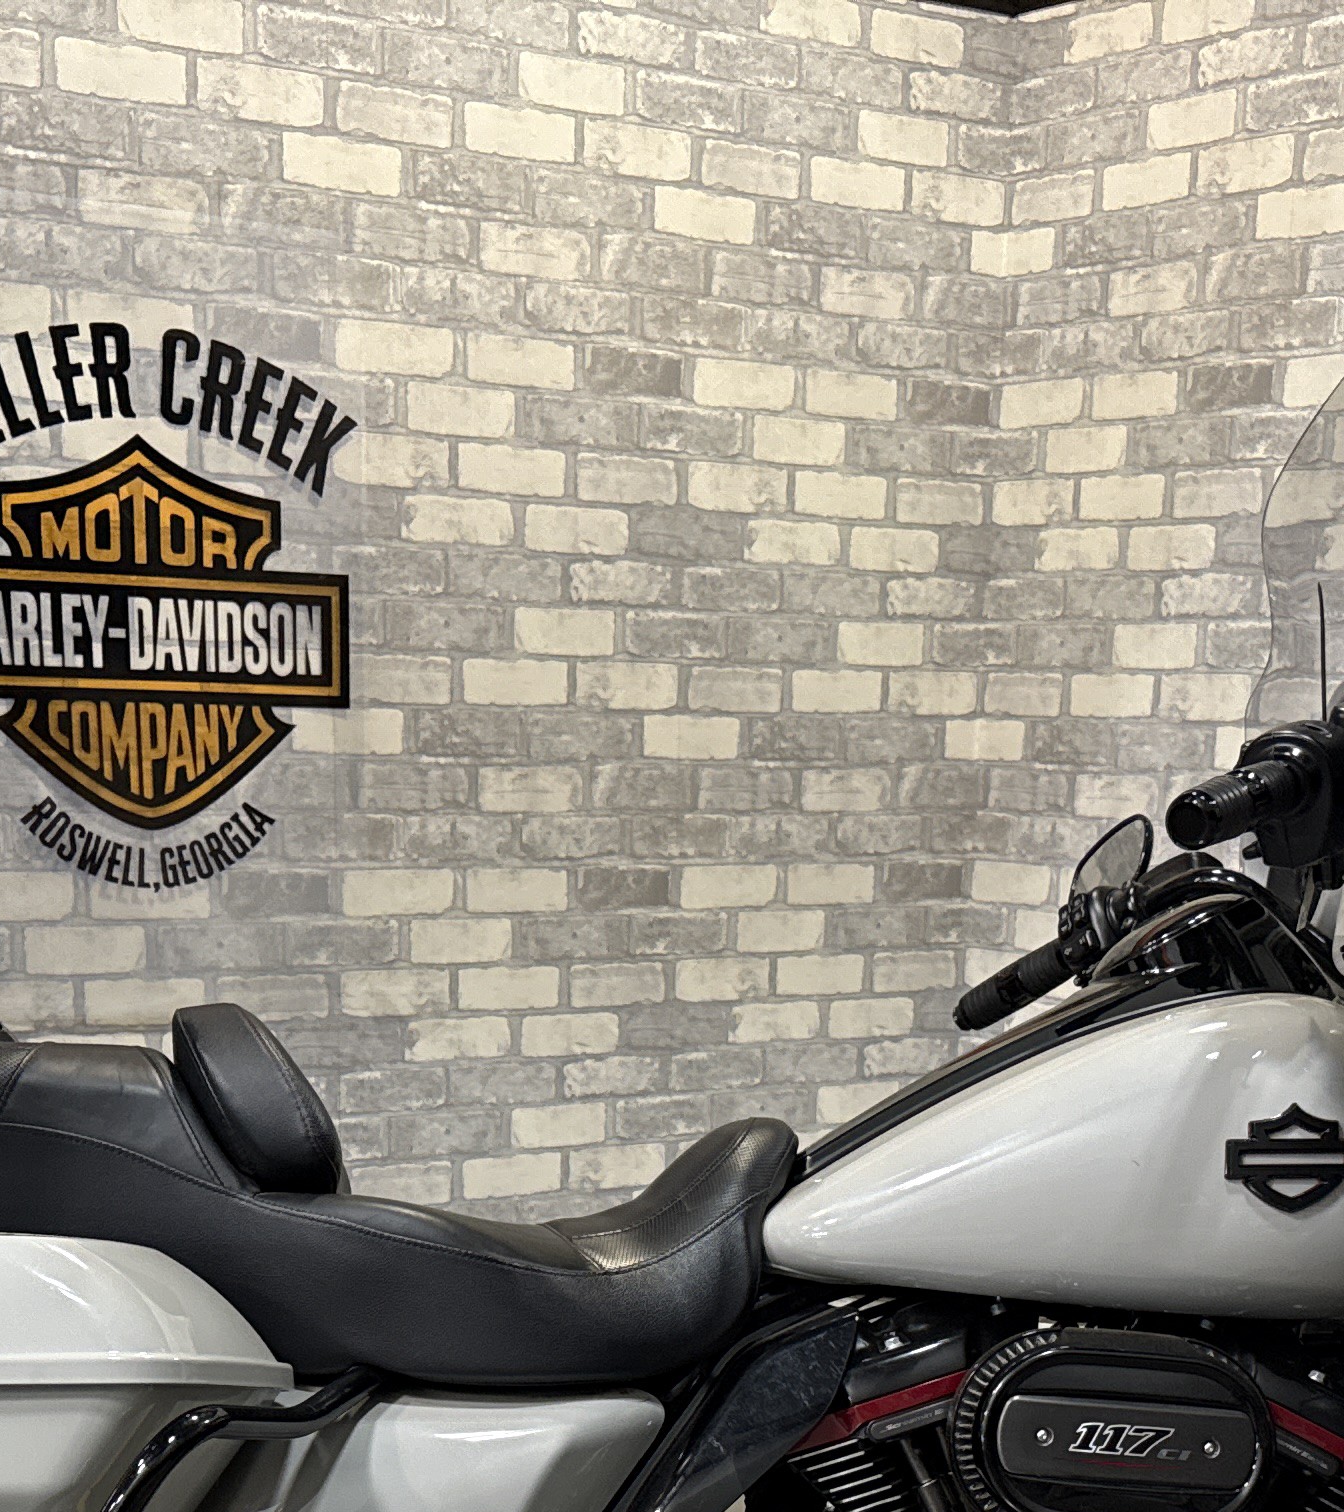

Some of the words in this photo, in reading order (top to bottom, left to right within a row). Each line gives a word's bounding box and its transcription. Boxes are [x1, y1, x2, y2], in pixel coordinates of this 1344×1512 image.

[159, 327, 358, 499] CREEK
[40, 476, 238, 571] MOTOR
[47, 699, 246, 800] COMPANY
[1068, 1421, 1175, 1458] 117
